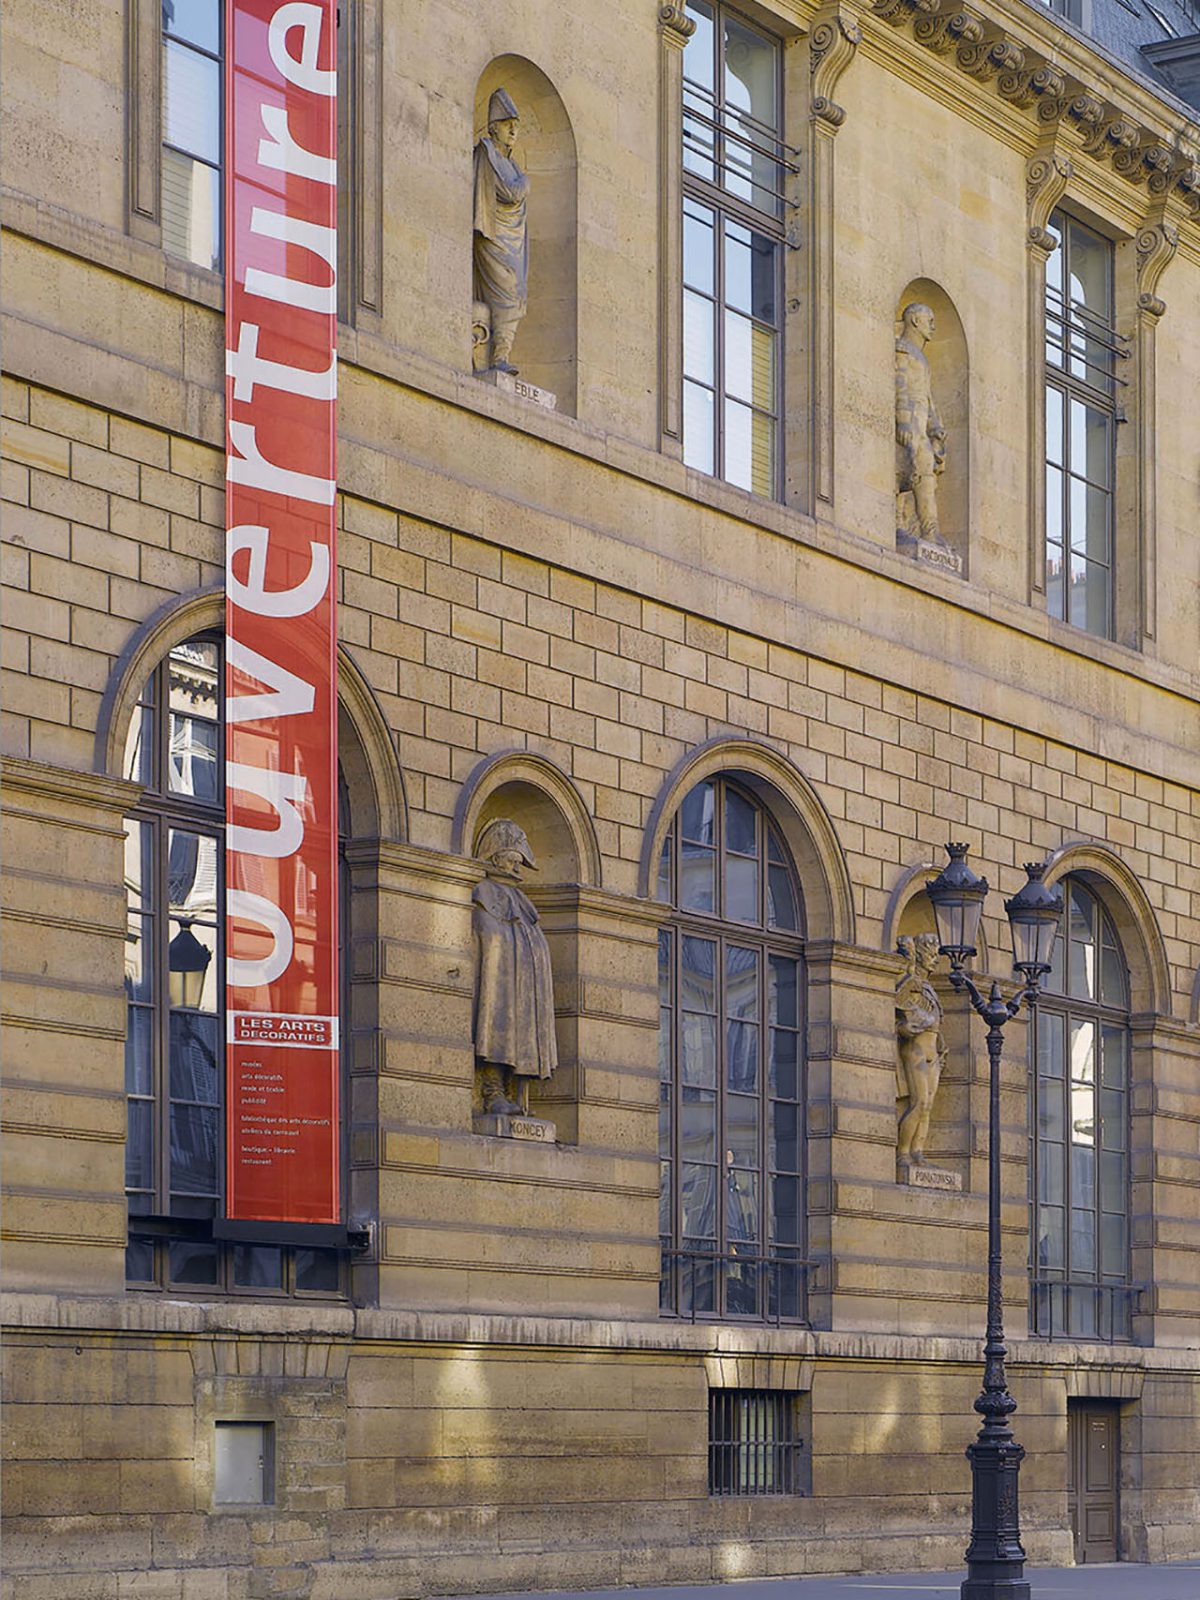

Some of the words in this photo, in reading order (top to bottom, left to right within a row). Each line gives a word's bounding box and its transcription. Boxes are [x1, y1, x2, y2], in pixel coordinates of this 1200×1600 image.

[226, 2, 337, 987] ouverture
[241, 1018, 273, 1029] LES
[280, 1020, 325, 1032] ARTS
[241, 1030, 325, 1042] DECORATIFS
